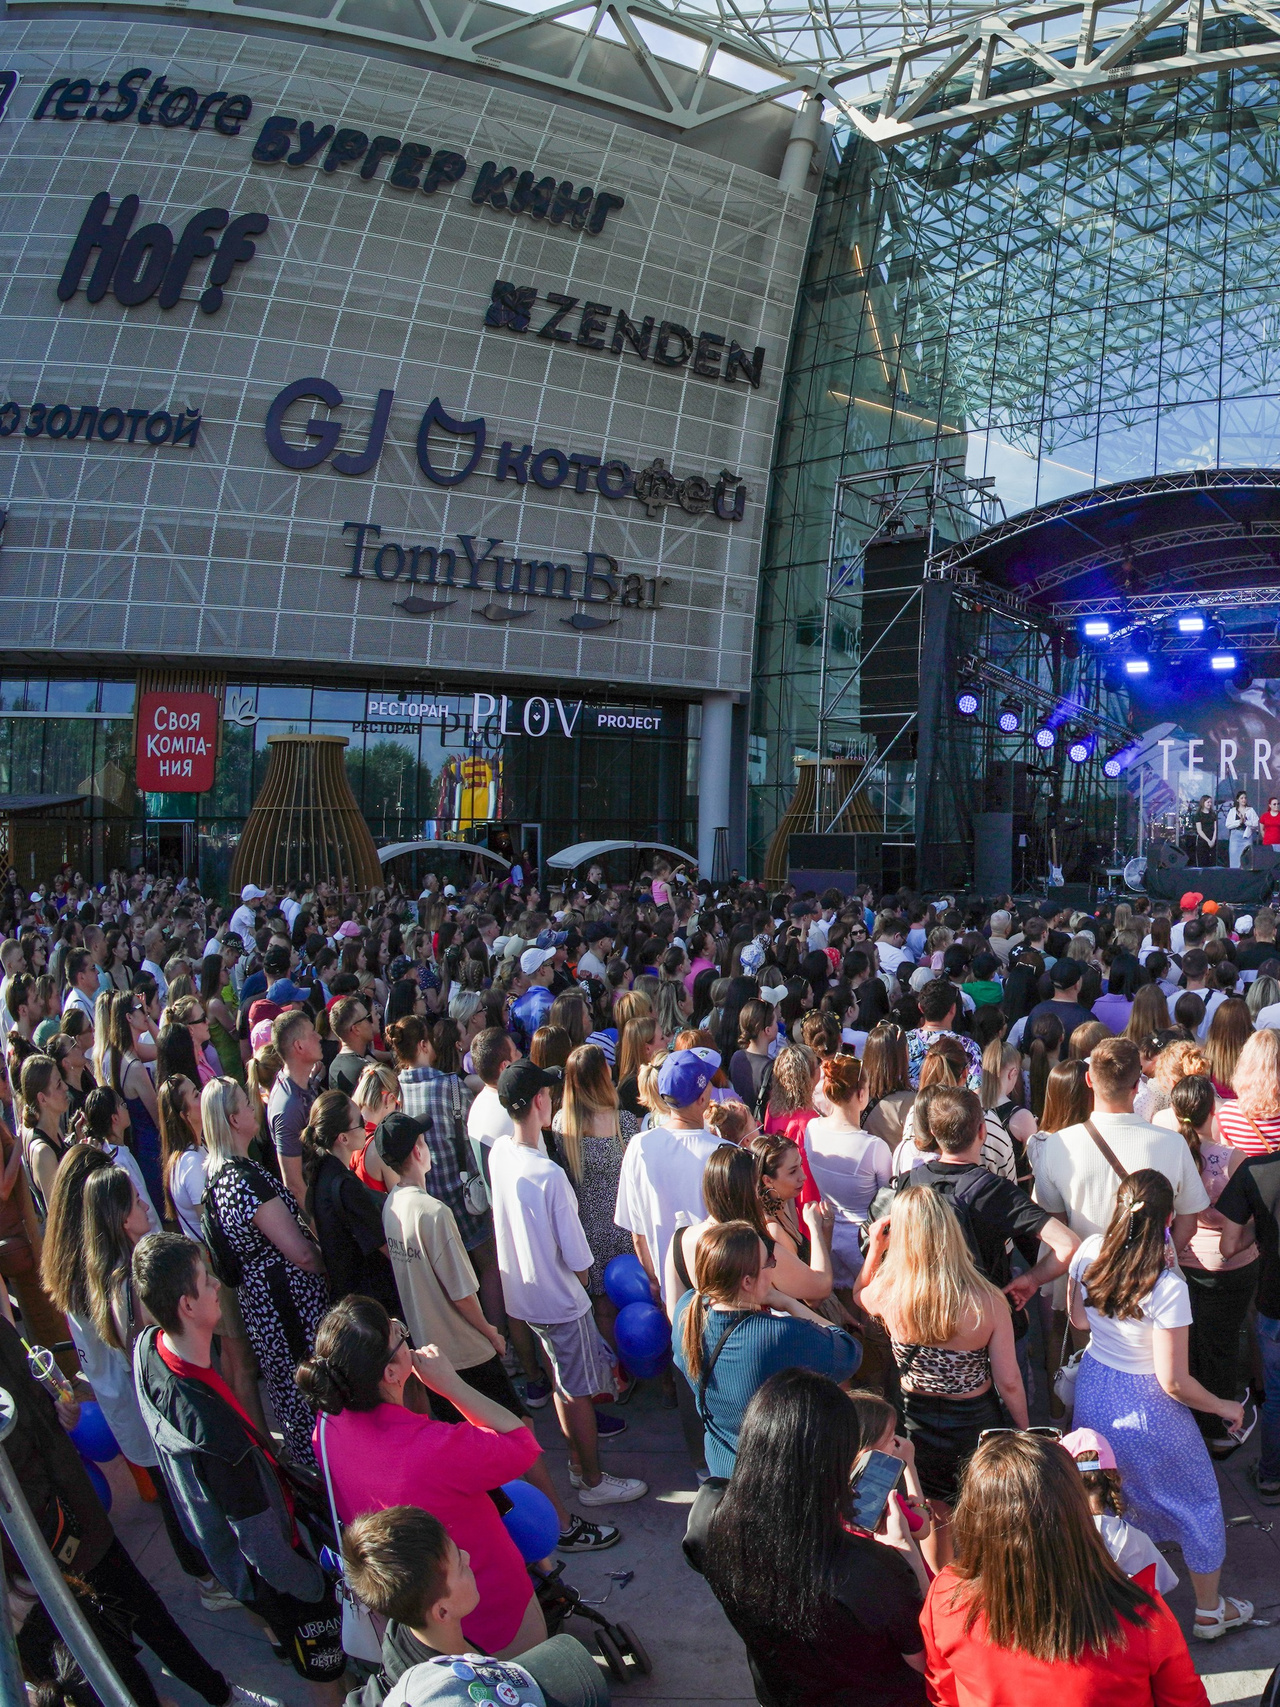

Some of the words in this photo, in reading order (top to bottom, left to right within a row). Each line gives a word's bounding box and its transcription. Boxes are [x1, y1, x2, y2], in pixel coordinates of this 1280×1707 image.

[33, 67, 253, 136] re:Store
[251, 115, 467, 196] БУРГЕР
[470, 160, 625, 236] КИНГ
[537, 291, 766, 390] ZENDEN
[266, 377, 394, 475] GJ
[496, 440, 746, 522] котофей
[368, 701, 449, 717] РЕСТОРАН
[472, 692, 583, 738] PLOV
[597, 714, 661, 730] PROJECT
[298, 1615, 342, 1638] URBAN
